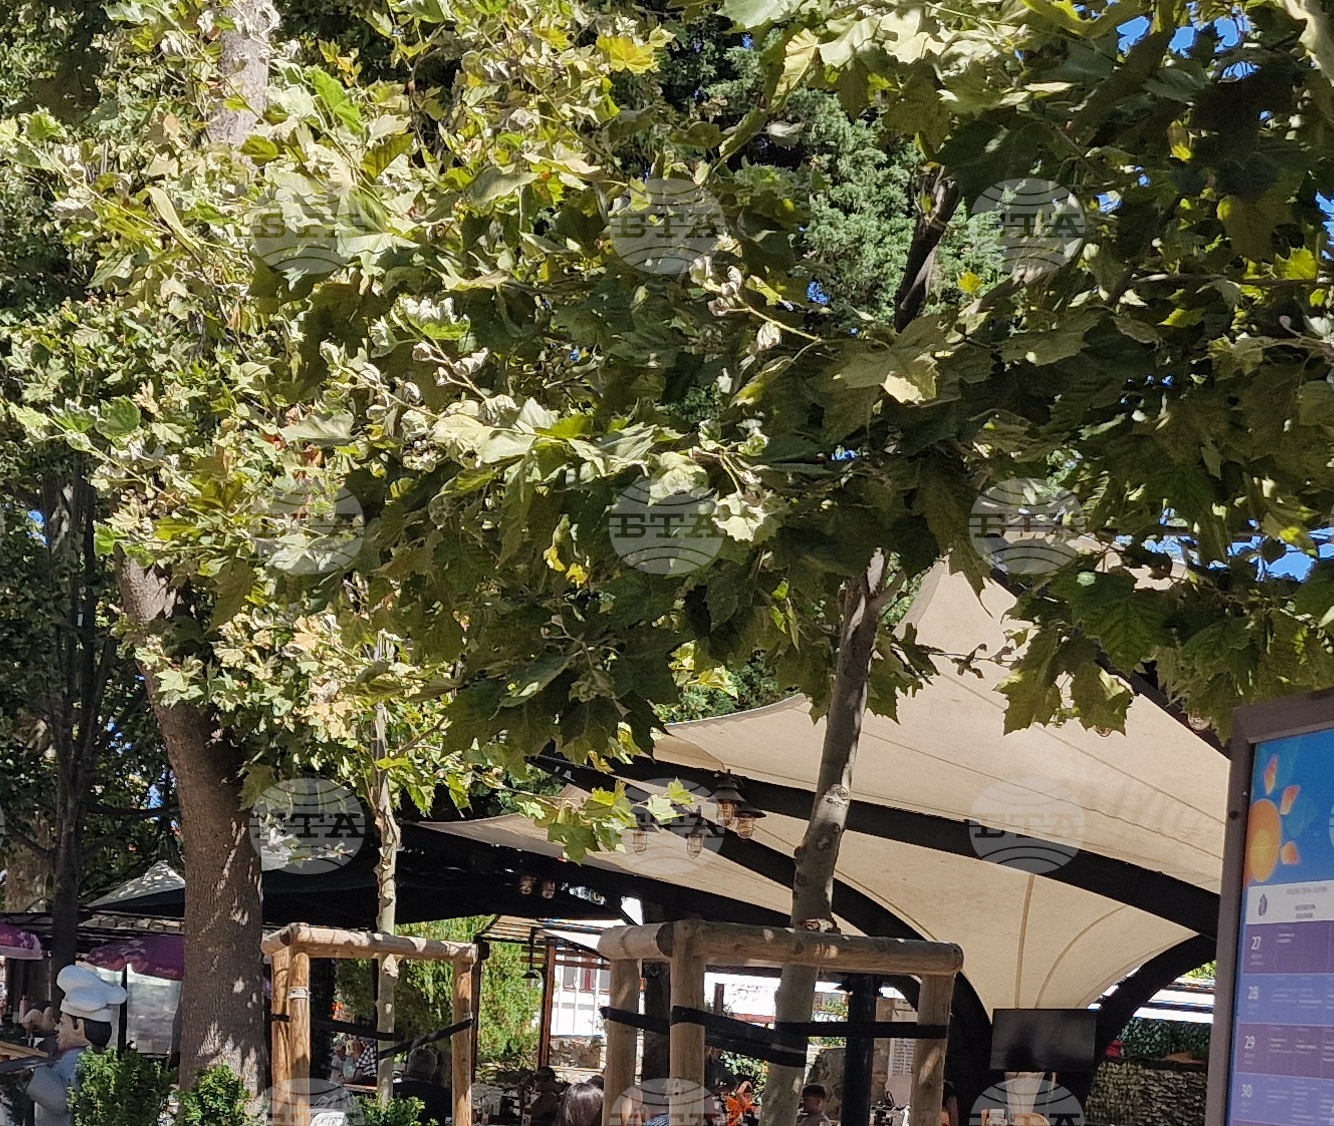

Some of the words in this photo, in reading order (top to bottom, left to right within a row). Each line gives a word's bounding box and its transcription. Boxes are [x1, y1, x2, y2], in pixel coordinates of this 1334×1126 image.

[1250, 936, 1262, 950] 27
[1247, 986, 1259, 999] 28
[1244, 1035, 1256, 1050] 29
[1240, 1084, 1253, 1099] 30
